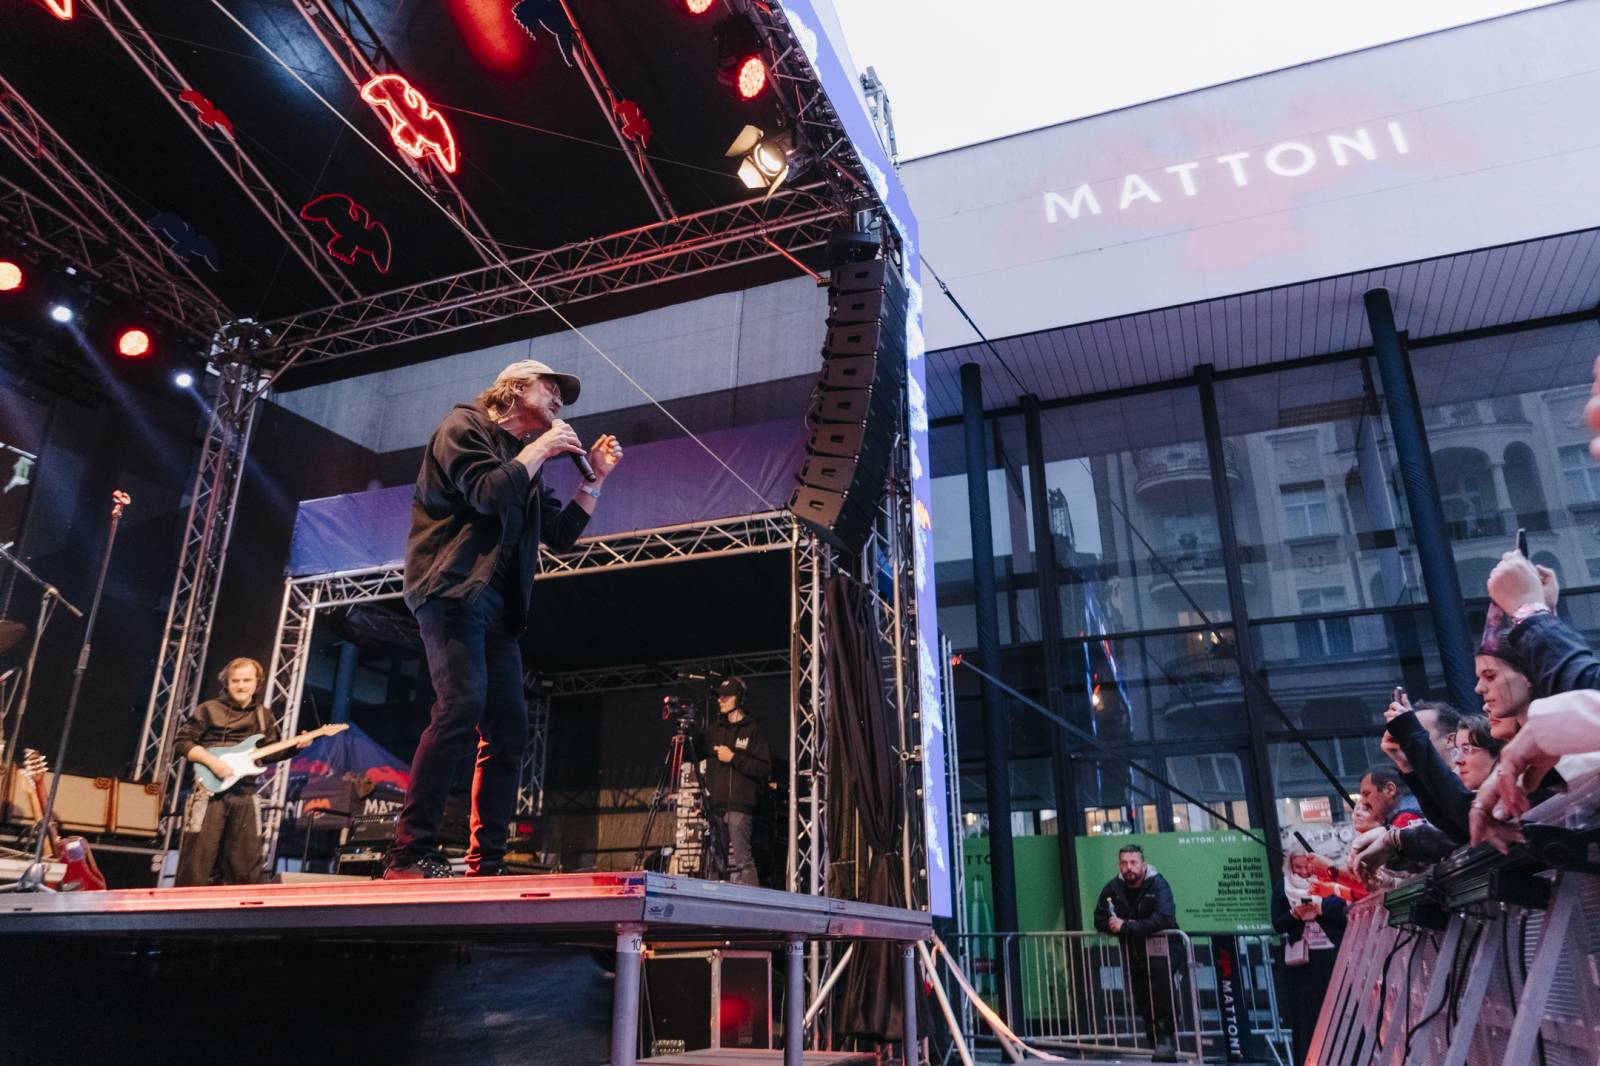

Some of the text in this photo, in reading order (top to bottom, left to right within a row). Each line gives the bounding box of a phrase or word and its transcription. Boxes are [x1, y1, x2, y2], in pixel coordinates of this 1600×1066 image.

[1043, 120, 1410, 224] MATTONI
[1178, 836, 1215, 844] MATTONI
[1222, 979, 1241, 1058] MATTONI
